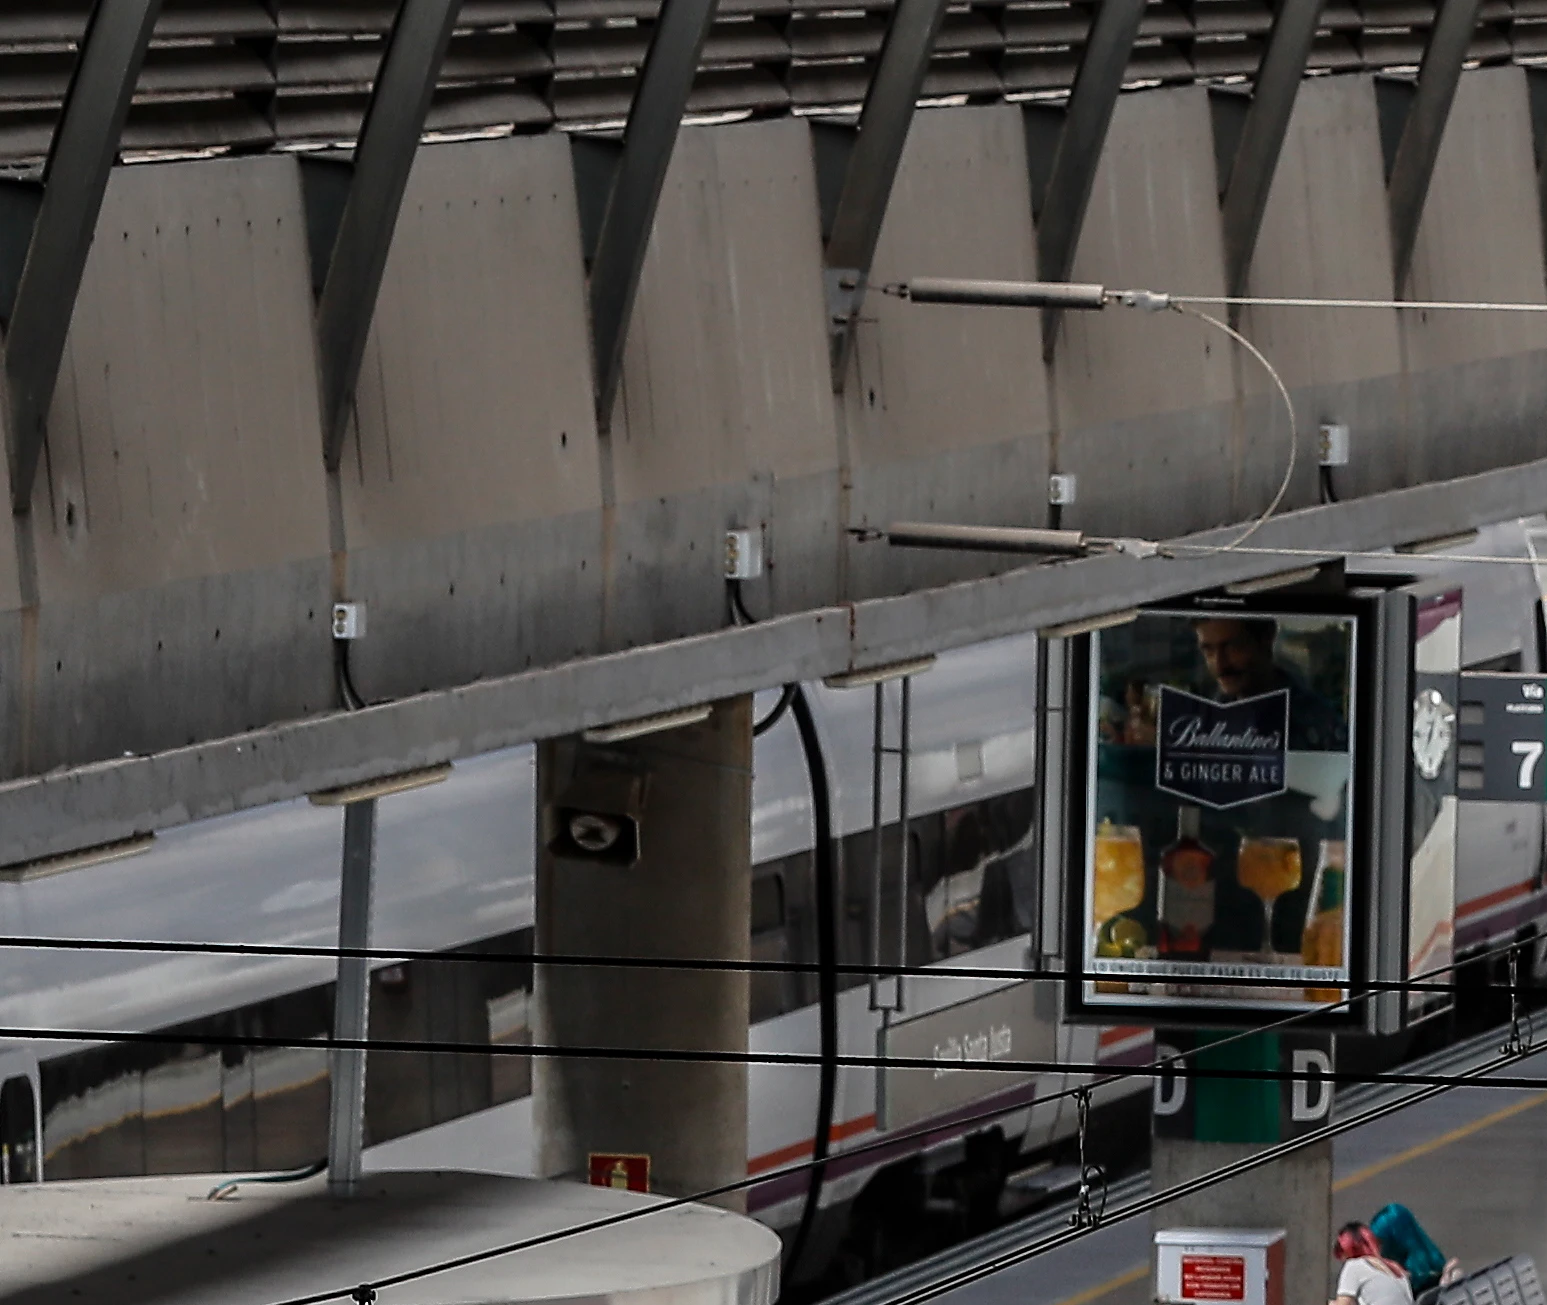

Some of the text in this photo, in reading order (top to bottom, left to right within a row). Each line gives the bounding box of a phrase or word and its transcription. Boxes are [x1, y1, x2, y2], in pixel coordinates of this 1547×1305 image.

[1179, 763, 1244, 782] GINGER
[1249, 765, 1281, 785] ALE
[1511, 741, 1544, 789] 7
[1153, 1044, 1187, 1115] D
[1292, 1049, 1334, 1121] D
